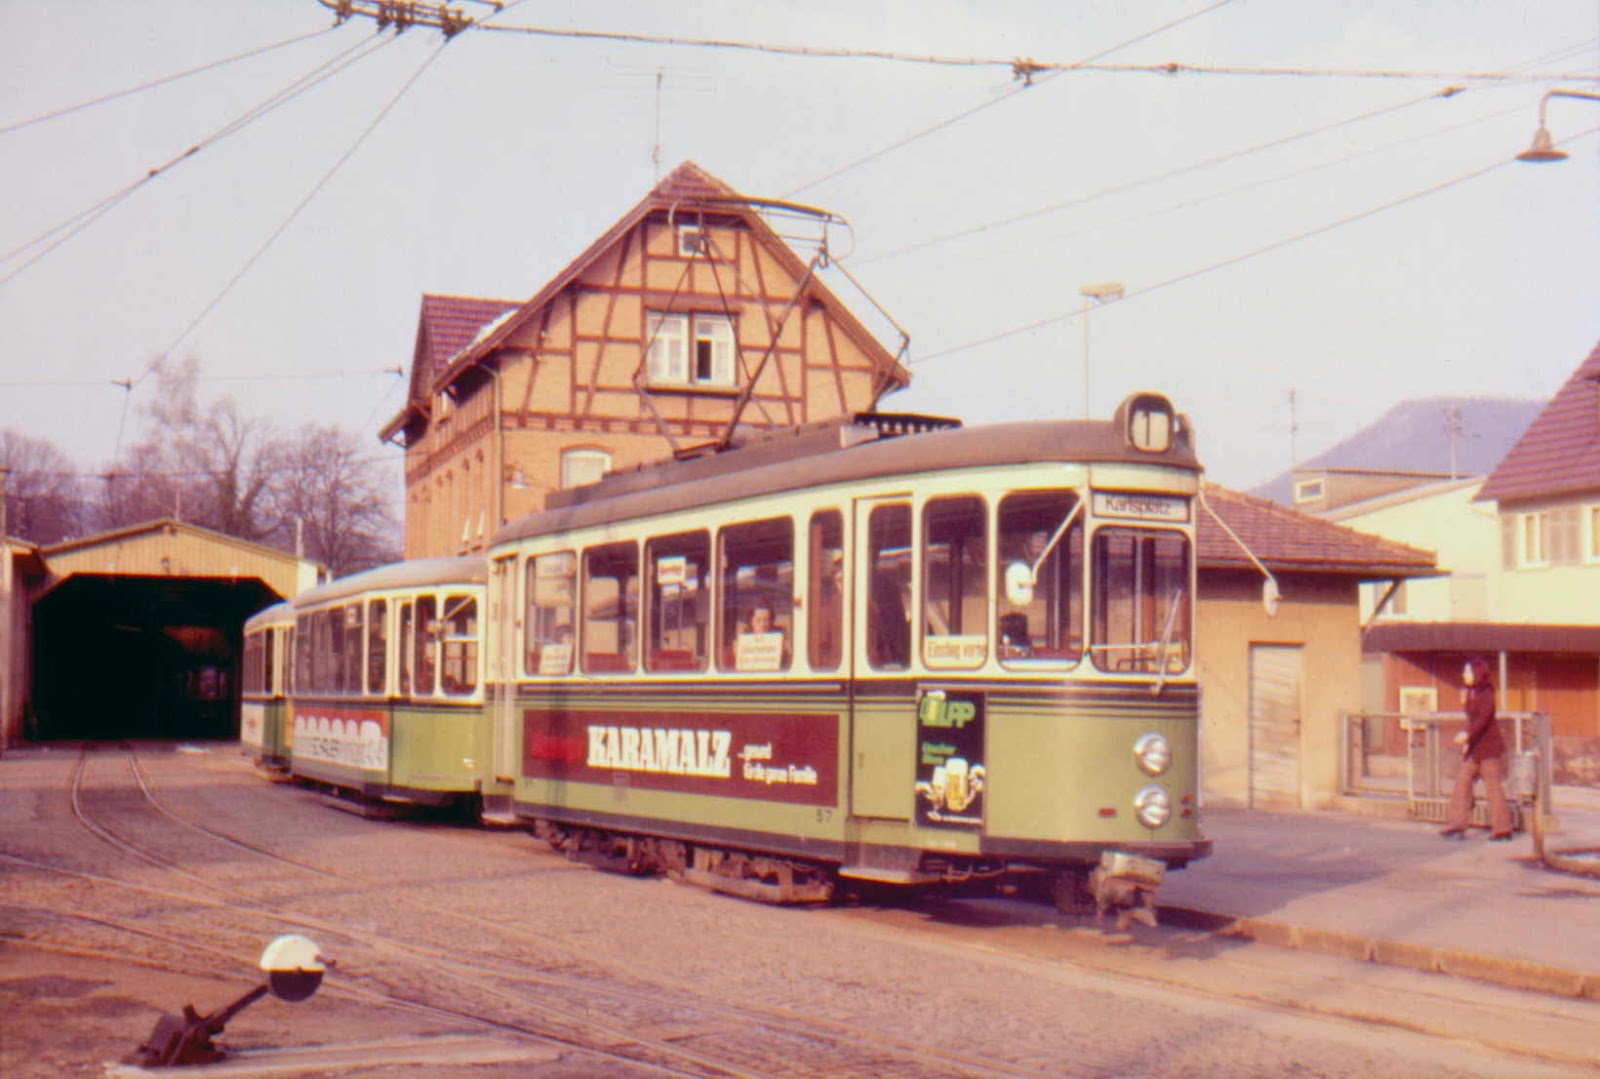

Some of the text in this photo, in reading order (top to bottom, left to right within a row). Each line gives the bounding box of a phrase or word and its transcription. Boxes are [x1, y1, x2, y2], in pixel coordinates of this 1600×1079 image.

[1142, 411, 1151, 447] 1
[1105, 495, 1172, 515] Karlsplatz
[587, 725, 732, 779] KARAMALZ
[816, 809, 832, 823] 57
